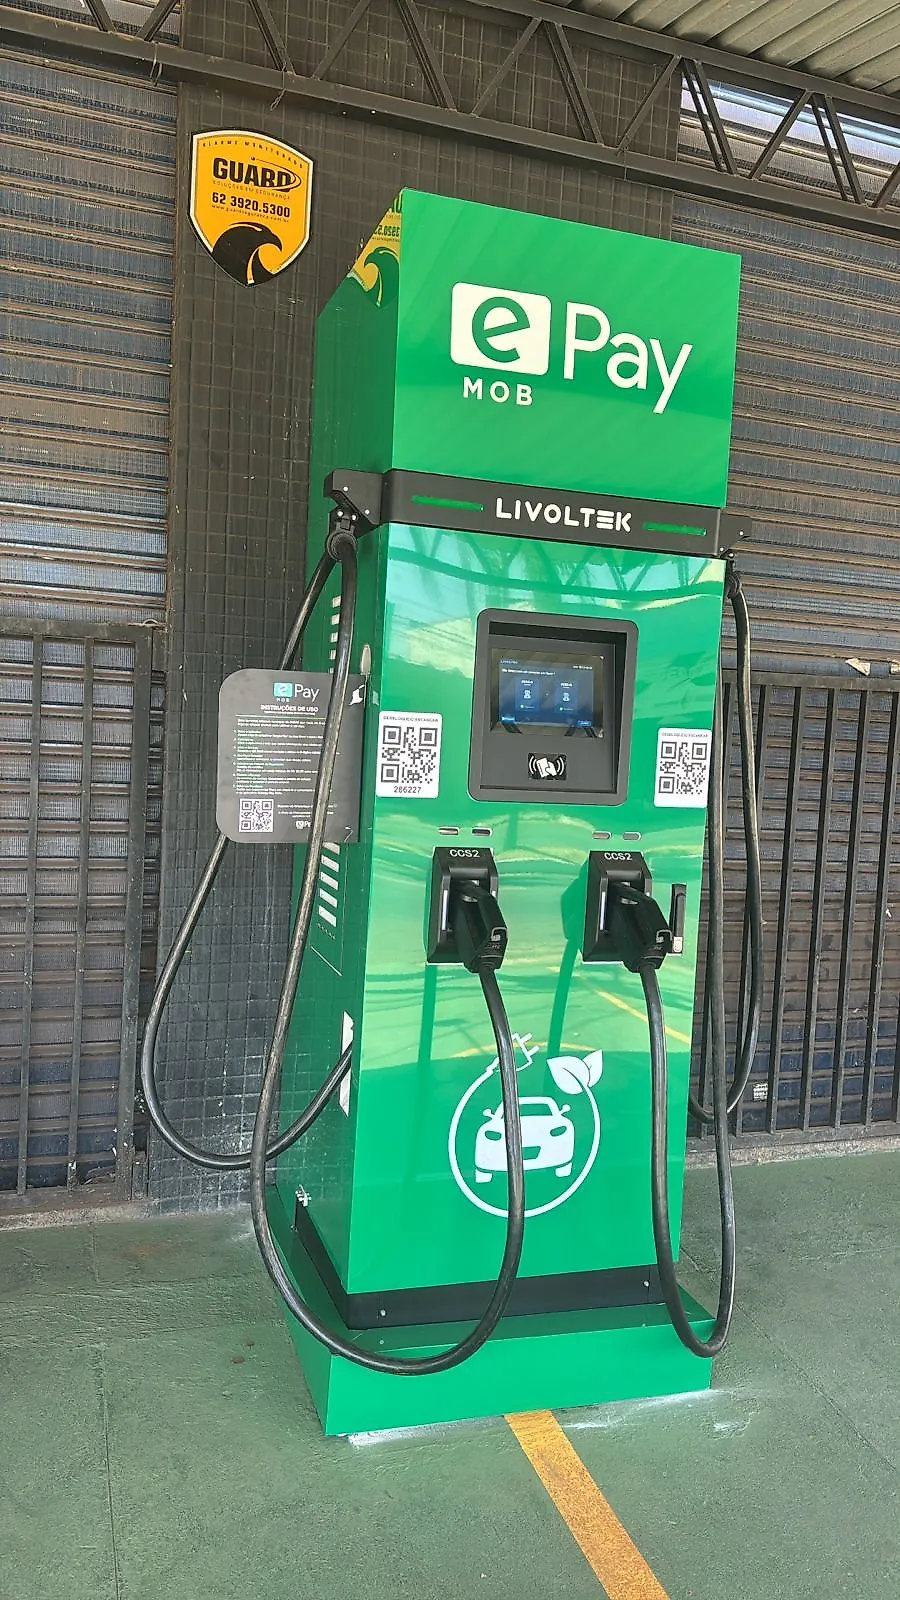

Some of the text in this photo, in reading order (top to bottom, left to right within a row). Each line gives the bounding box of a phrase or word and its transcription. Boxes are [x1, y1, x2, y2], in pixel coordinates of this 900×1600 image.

[213, 157, 298, 193] GUARD
[212, 191, 291, 218] 62 3920.5300
[463, 376, 533, 406] MOB
[496, 497, 632, 533] LIVOLTEK
[393, 785, 422, 795] 286227
[449, 848, 481, 859] CCS2
[604, 851, 633, 862] CCS2
